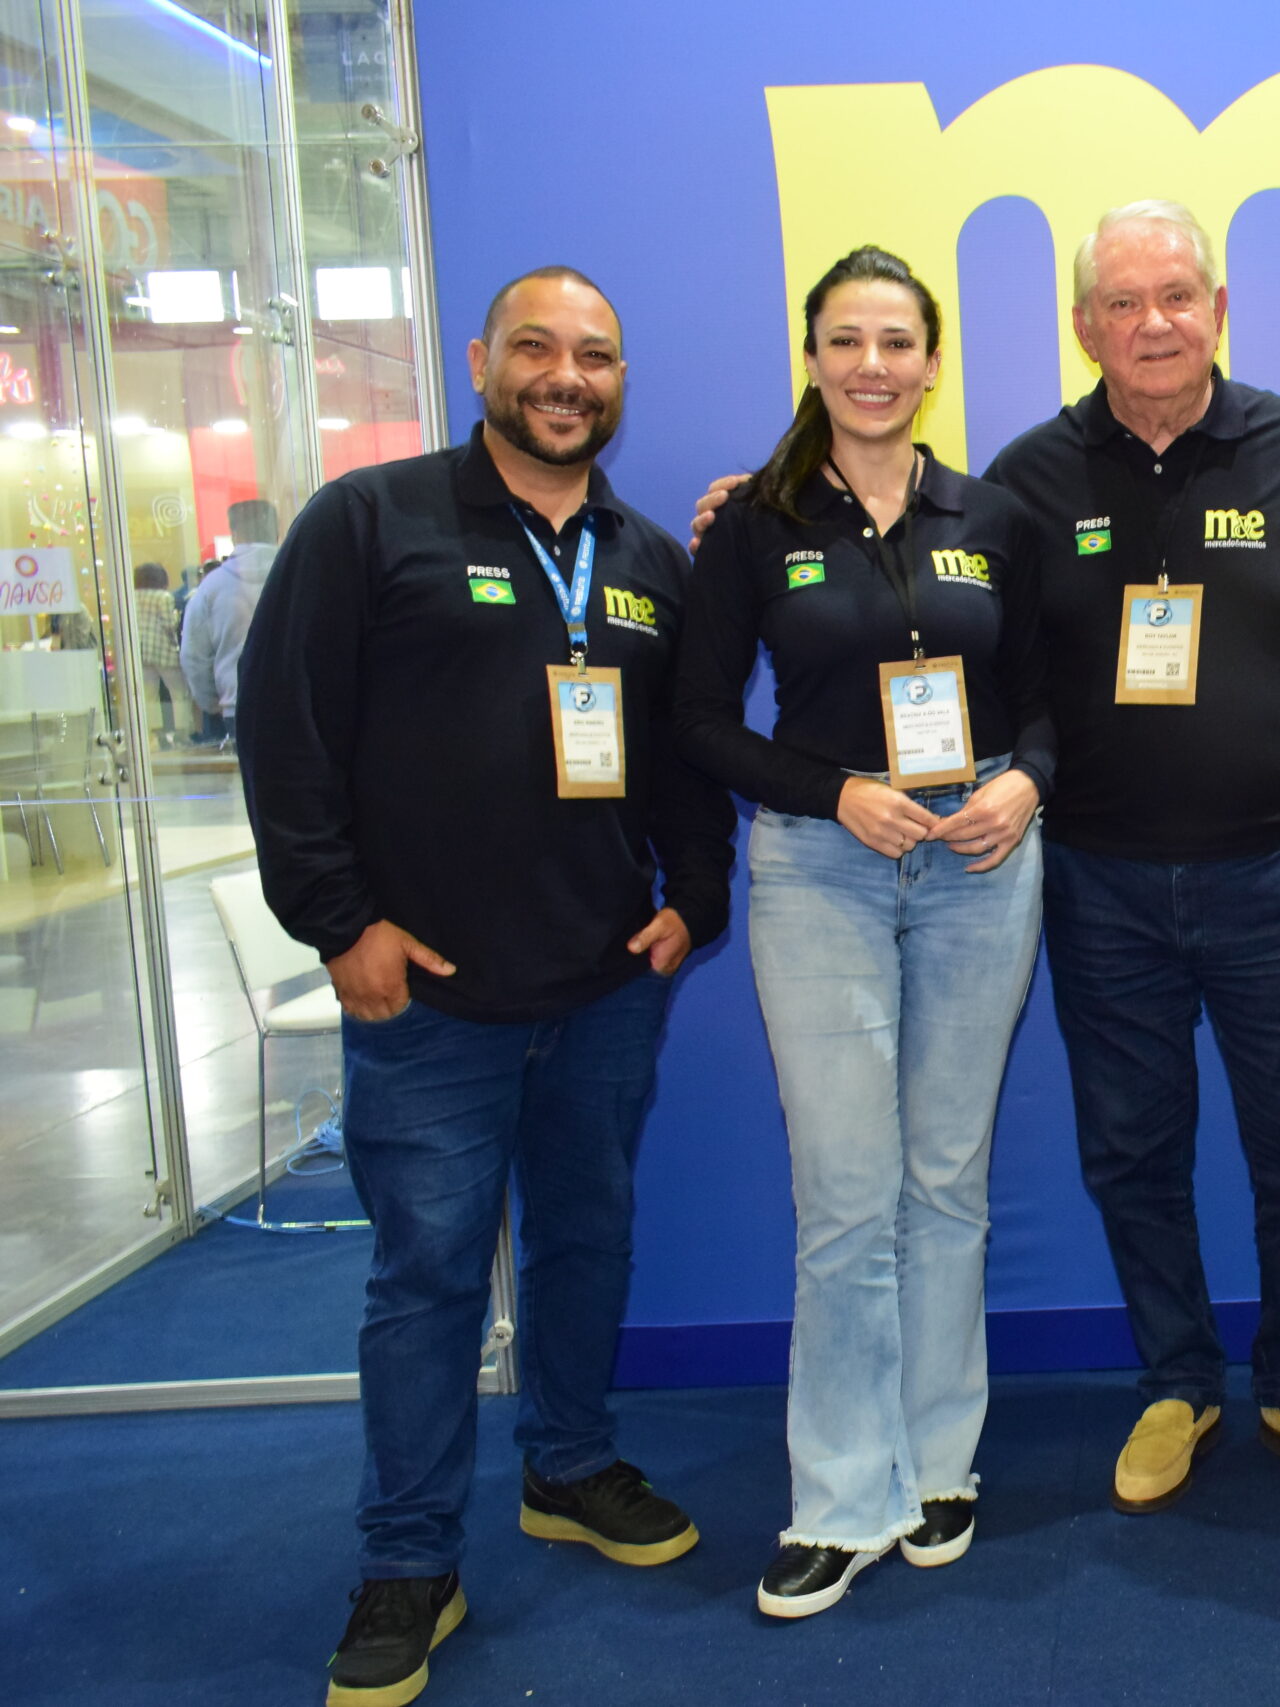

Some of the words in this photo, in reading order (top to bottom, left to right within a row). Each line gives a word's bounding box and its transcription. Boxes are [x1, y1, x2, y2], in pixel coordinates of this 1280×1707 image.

[1076, 516, 1111, 532] PRESS
[1205, 508, 1265, 540] m&e
[785, 550, 824, 565] PRESS
[931, 548, 990, 582] m&e
[467, 564, 510, 578] PRESS
